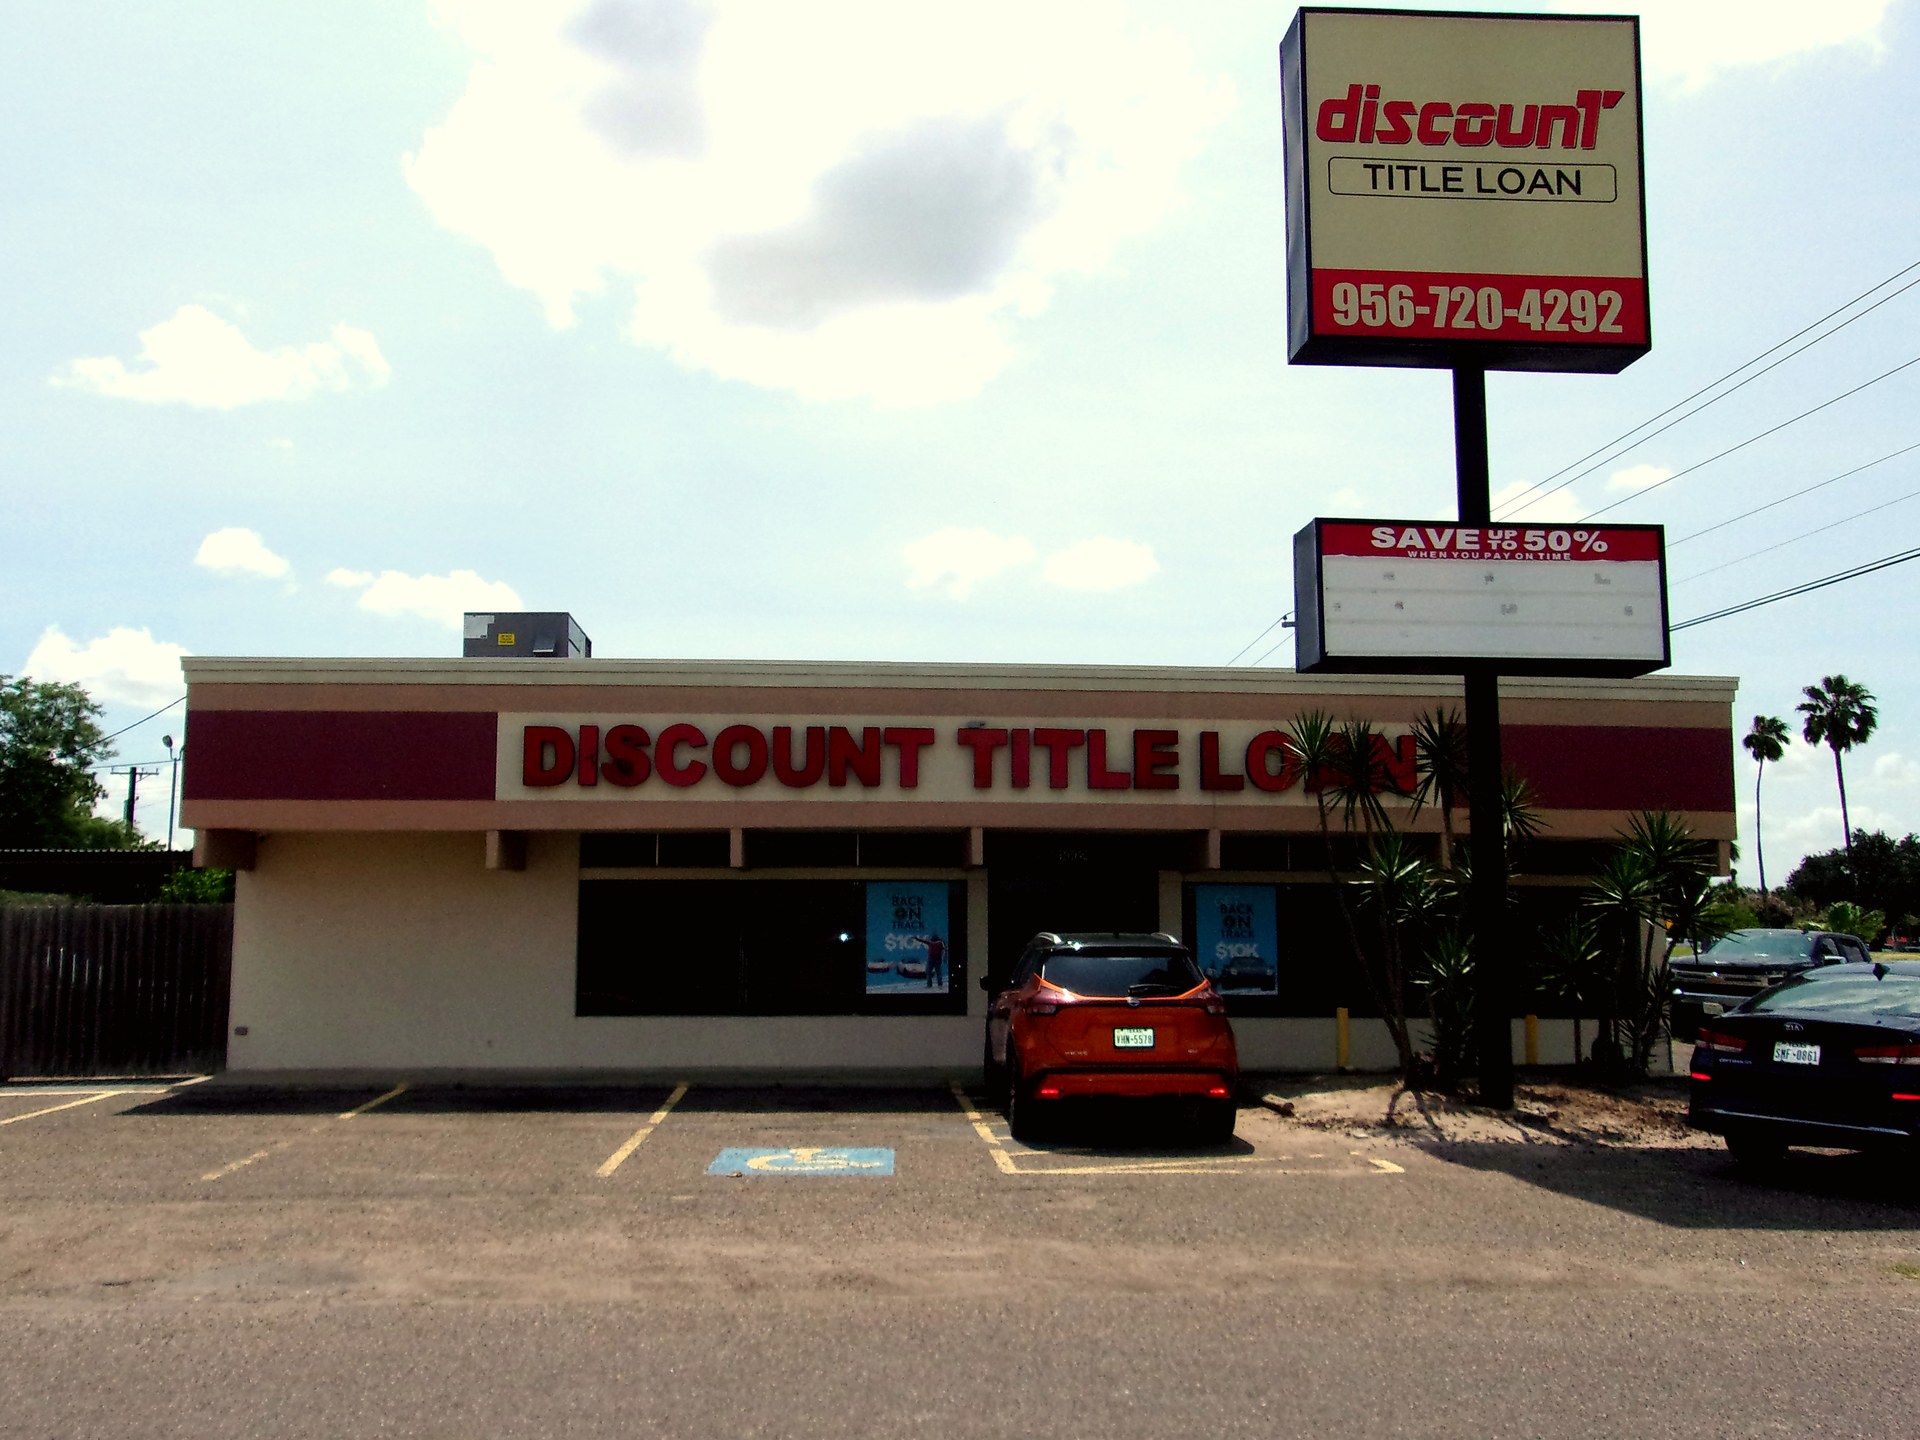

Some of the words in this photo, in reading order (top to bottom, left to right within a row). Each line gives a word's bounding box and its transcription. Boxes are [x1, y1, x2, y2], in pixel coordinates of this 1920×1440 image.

[1363, 163, 1463, 193] TITLE
[1476, 167, 1582, 196] LOAN
[1332, 281, 1623, 333] 956-720-4292
[1370, 527, 1480, 550] SAVE
[1488, 529, 1518, 540] UP
[1523, 529, 1608, 553] 50%
[1488, 540, 1518, 550] TO
[1407, 550, 1447, 559] WHEN
[1452, 551, 1480, 559] YOU
[1484, 552, 1507, 560] PAY
[1514, 552, 1534, 560] ON
[1539, 552, 1571, 561] TIME
[522, 723, 935, 788] DISCOUNT
[957, 727, 1180, 790] TITLE
[891, 895, 924, 906] BACK
[895, 906, 922, 920] ON
[1219, 903, 1255, 915] BACK
[1223, 914, 1251, 929] ON
